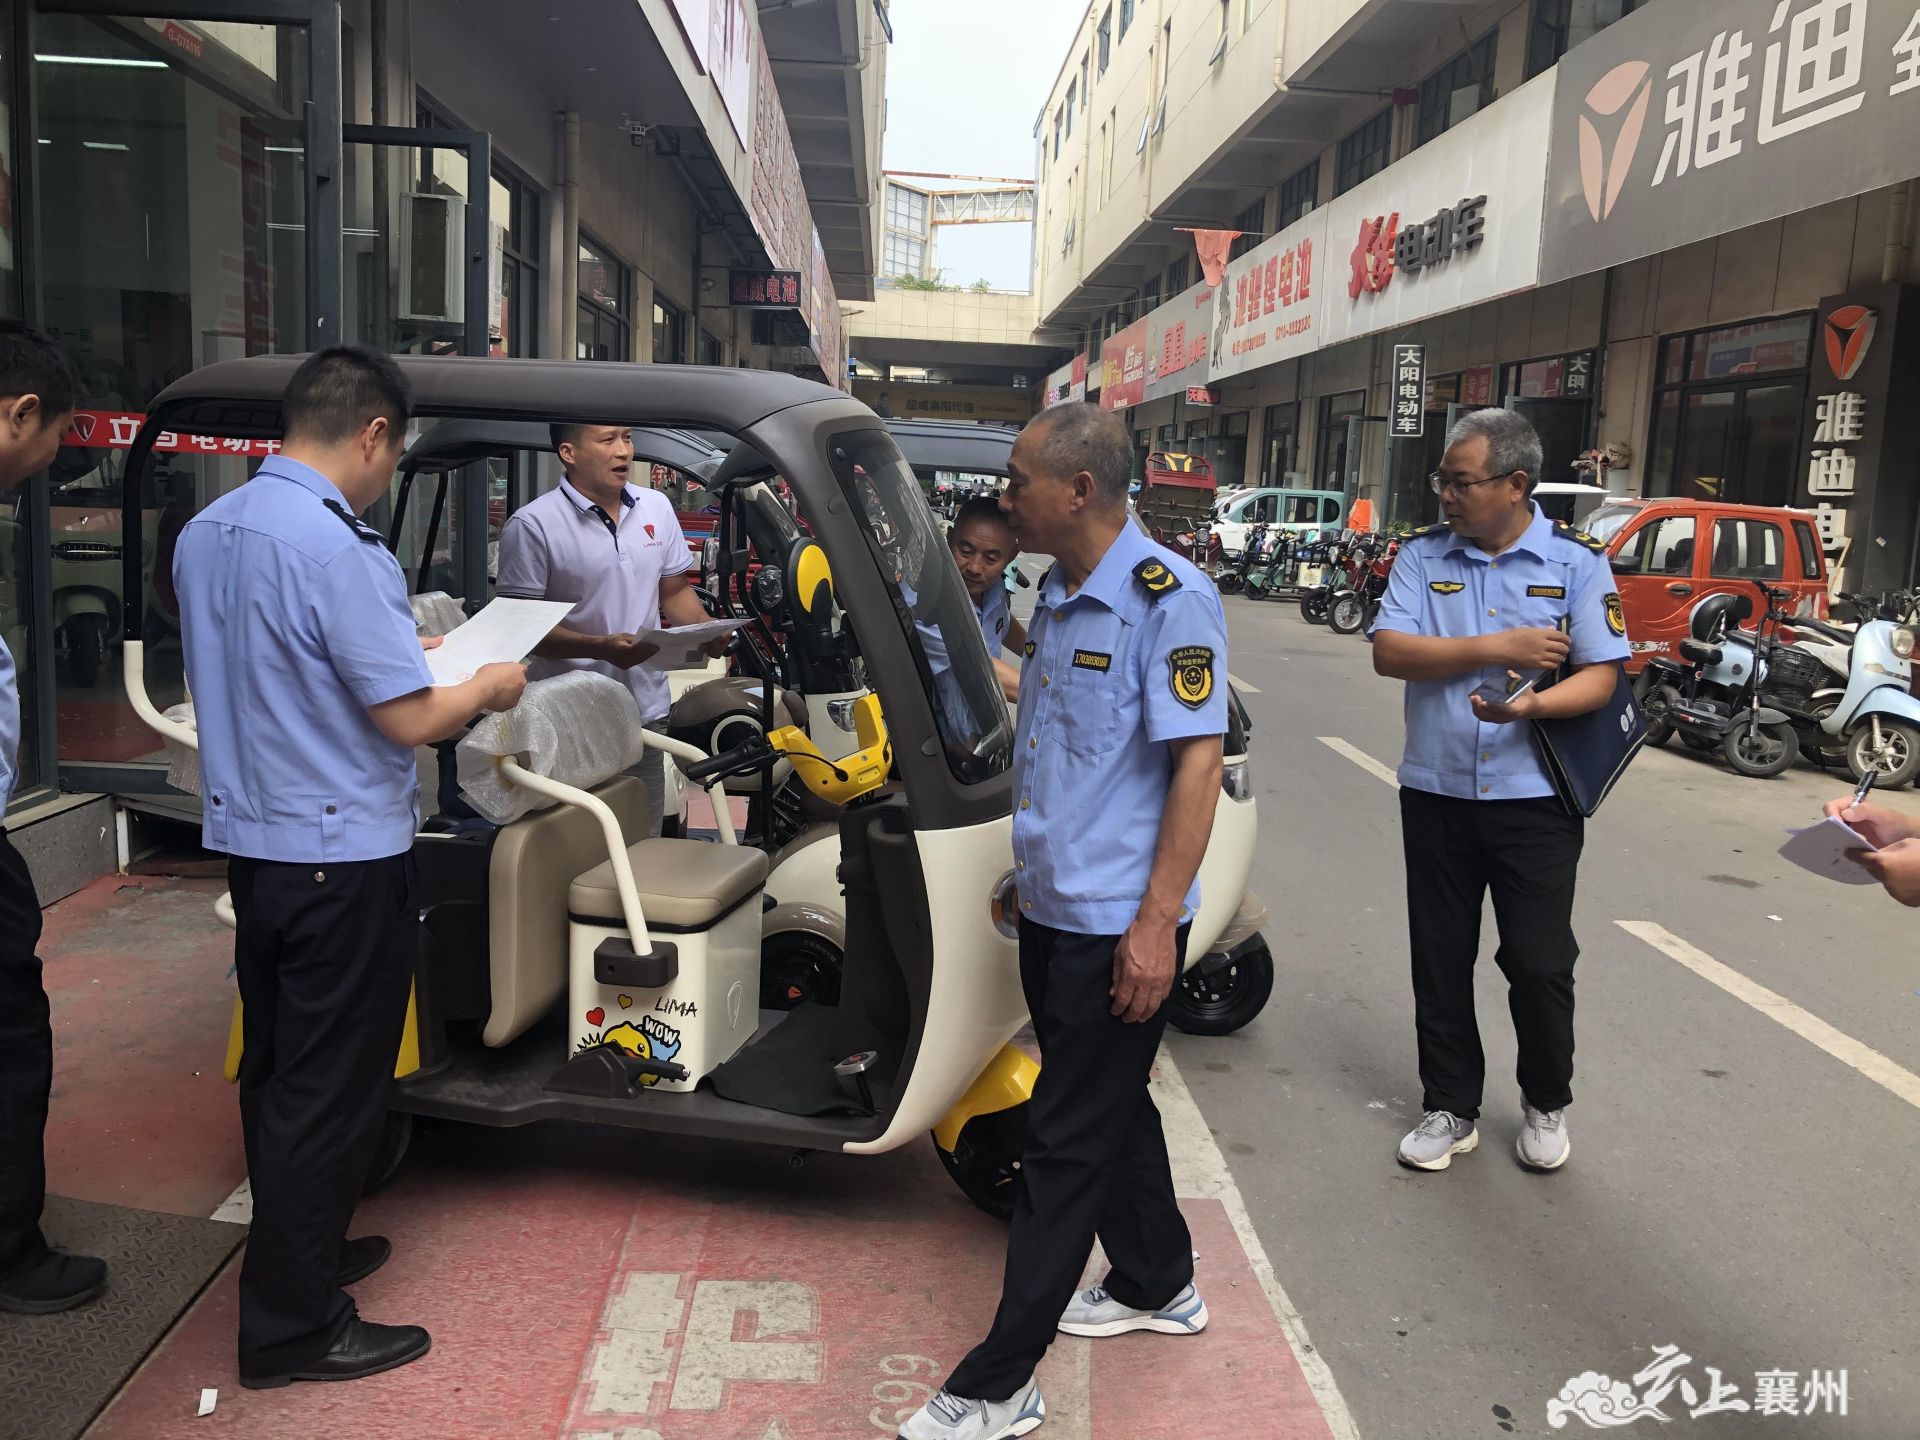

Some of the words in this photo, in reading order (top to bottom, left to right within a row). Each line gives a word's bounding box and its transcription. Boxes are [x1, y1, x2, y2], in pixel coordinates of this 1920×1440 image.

[1396, 348, 1422, 433] 大阳电动车
[655, 996, 698, 1018] LIMA
[645, 1016, 680, 1045] WOW
